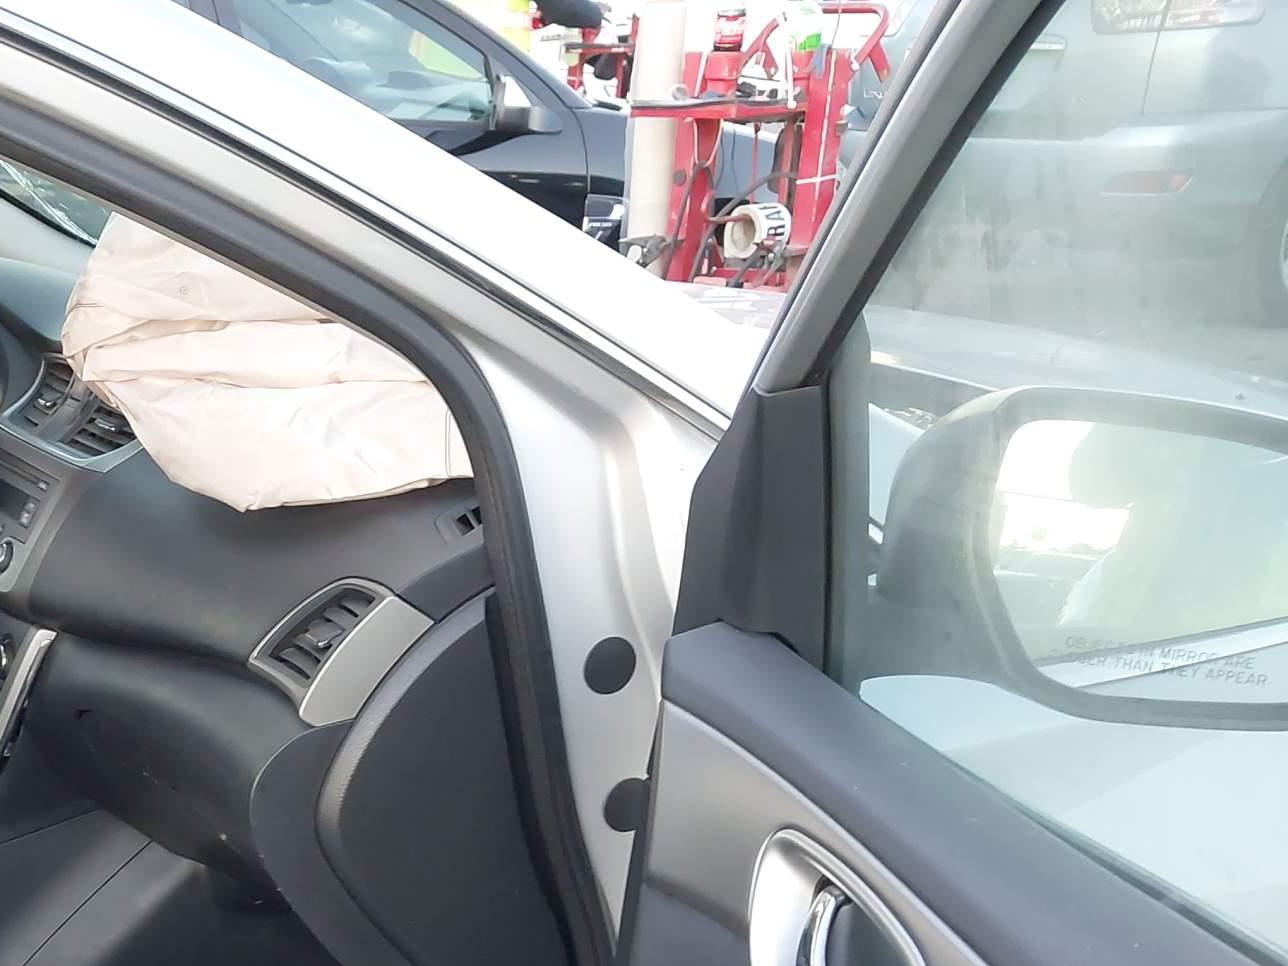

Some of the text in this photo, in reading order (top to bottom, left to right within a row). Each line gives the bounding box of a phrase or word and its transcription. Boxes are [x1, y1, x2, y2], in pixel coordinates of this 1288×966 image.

[1113, 656, 1154, 672] THAN
[1204, 668, 1269, 687] APPEAR
[1223, 656, 1256, 670] ARE
